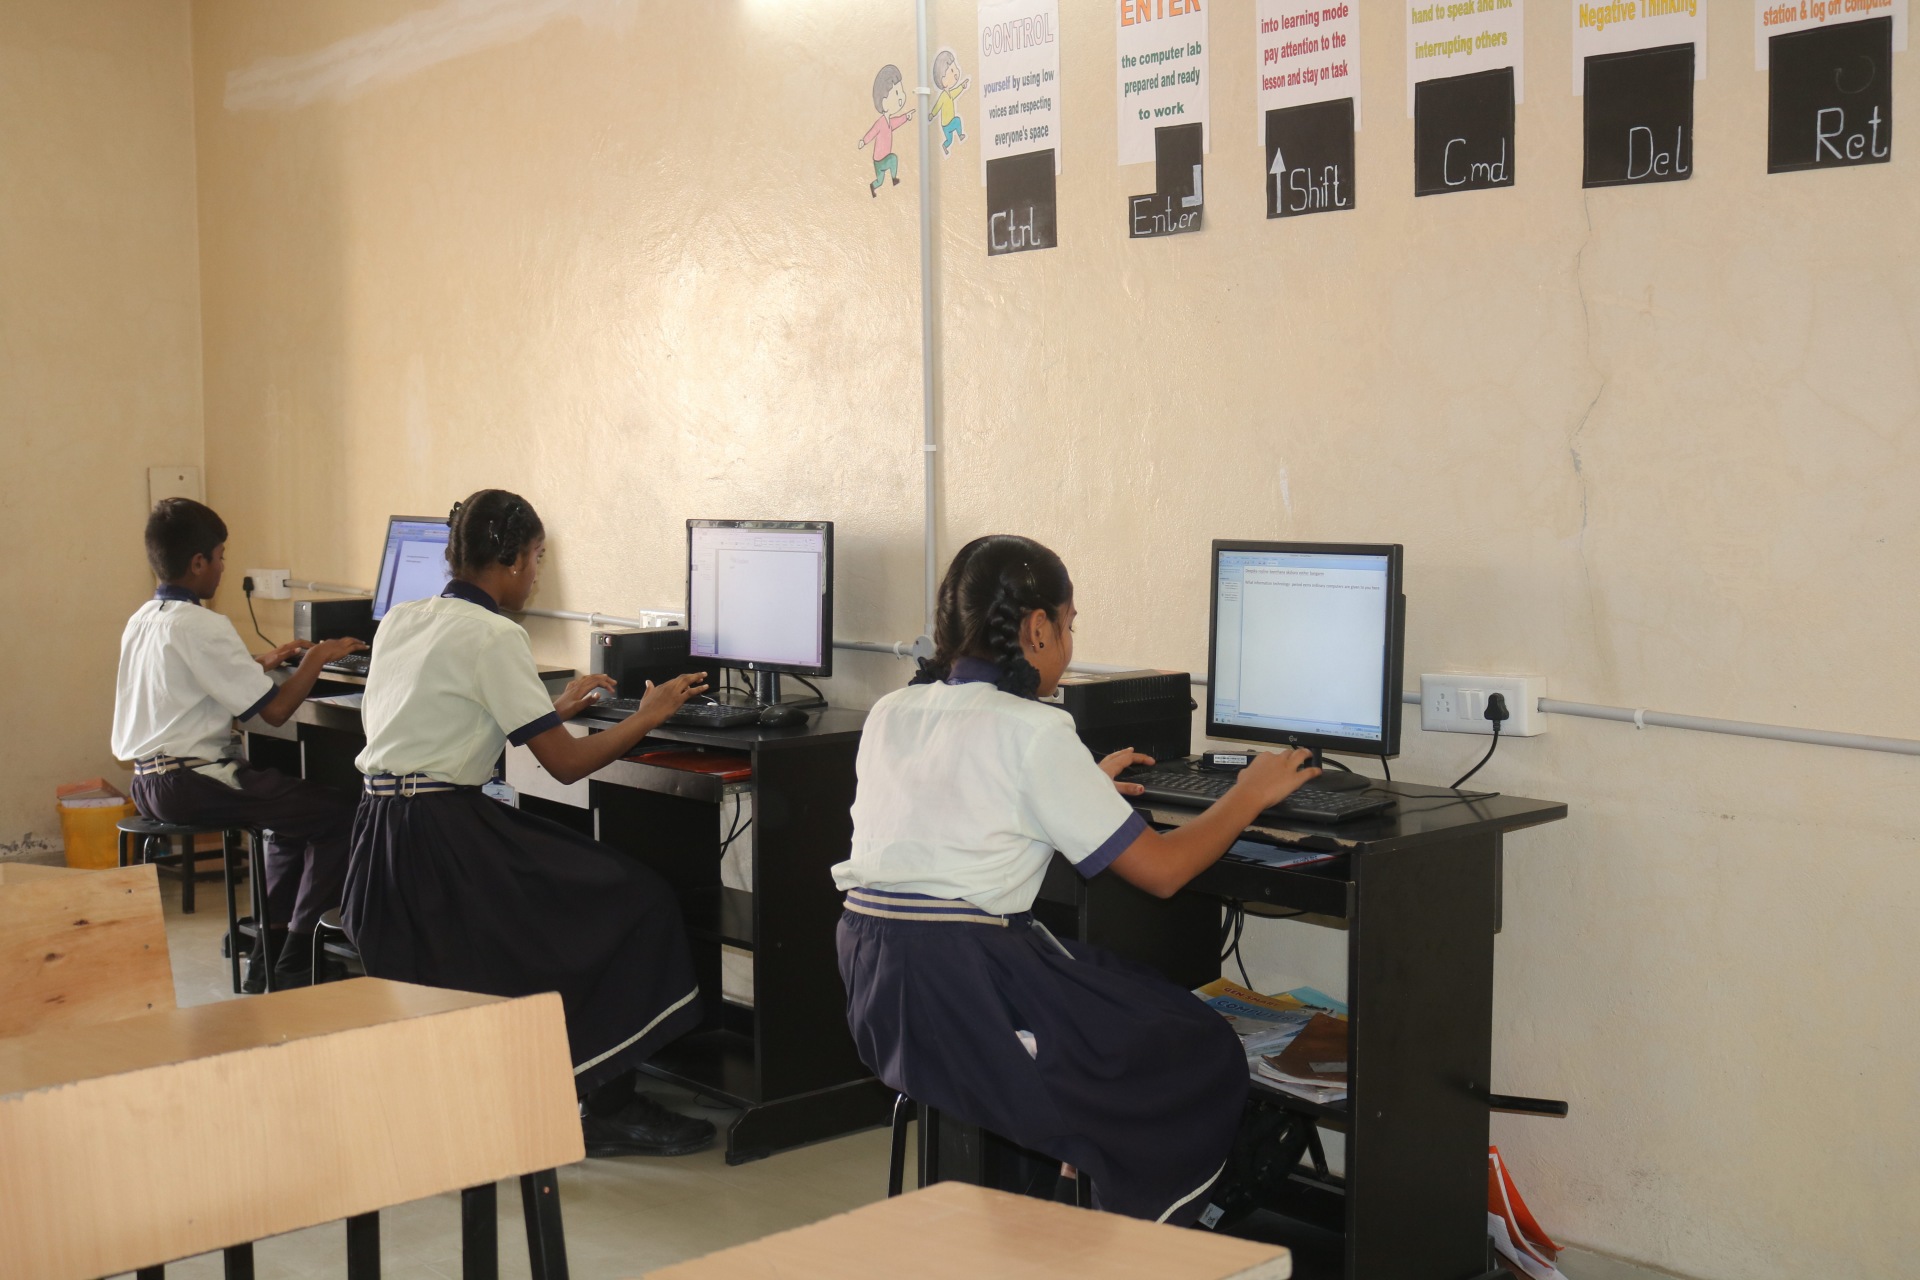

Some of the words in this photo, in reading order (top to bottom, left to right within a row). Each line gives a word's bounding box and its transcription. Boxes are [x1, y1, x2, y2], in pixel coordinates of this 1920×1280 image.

[1261, 18, 1279, 34] into
[1281, 9, 1320, 30] learning
[1322, 2, 1349, 22] mode
[1411, 4, 1434, 24] hand
[1435, 3, 1446, 20] to
[1447, 0, 1475, 21] speak
[1477, 0, 1495, 13] and
[1579, 0, 1637, 31] Negative
[1641, 0, 1698, 17] Thinking
[1763, 4, 1797, 26] station
[1799, 0, 1807, 20] &
[1810, 0, 1826, 22] log
[1828, 0, 1842, 16] off
[982, 12, 1054, 57] CONTROL
[1264, 47, 1279, 66] pay
[1280, 36, 1319, 59] attention
[1321, 34, 1330, 51] to
[1331, 31, 1347, 49] the
[1415, 34, 1473, 59] interrupting
[1475, 30, 1508, 50] others
[1121, 54, 1137, 69] the
[1139, 46, 1185, 66] computer
[1186, 40, 1202, 57] lab
[983, 75, 1011, 98] yourself
[1012, 74, 1021, 92] by
[1022, 71, 1041, 88] using
[1042, 68, 1055, 83] low
[1124, 73, 1159, 98] prepared
[1161, 70, 1176, 88] and
[1178, 66, 1201, 86] ready
[1262, 74, 1286, 91] lesson
[1287, 67, 1301, 86] and
[1302, 66, 1319, 86] stay
[1320, 66, 1330, 81] on
[1331, 59, 1349, 79] task
[988, 104, 1008, 119] voices
[1008, 100, 1020, 116] and
[1020, 96, 1052, 116] respecting
[1138, 108, 1151, 121] to
[1154, 101, 1185, 118] work
[994, 125, 1029, 147] everyone's
[1029, 124, 1049, 143] space
[1815, 105, 1889, 162] Ret
[1443, 137, 1509, 186] Cmd
[1626, 125, 1689, 180] Del
[1290, 165, 1347, 212] Shift
[990, 206, 1041, 250] Ctrl
[1133, 195, 1198, 235] Enter
